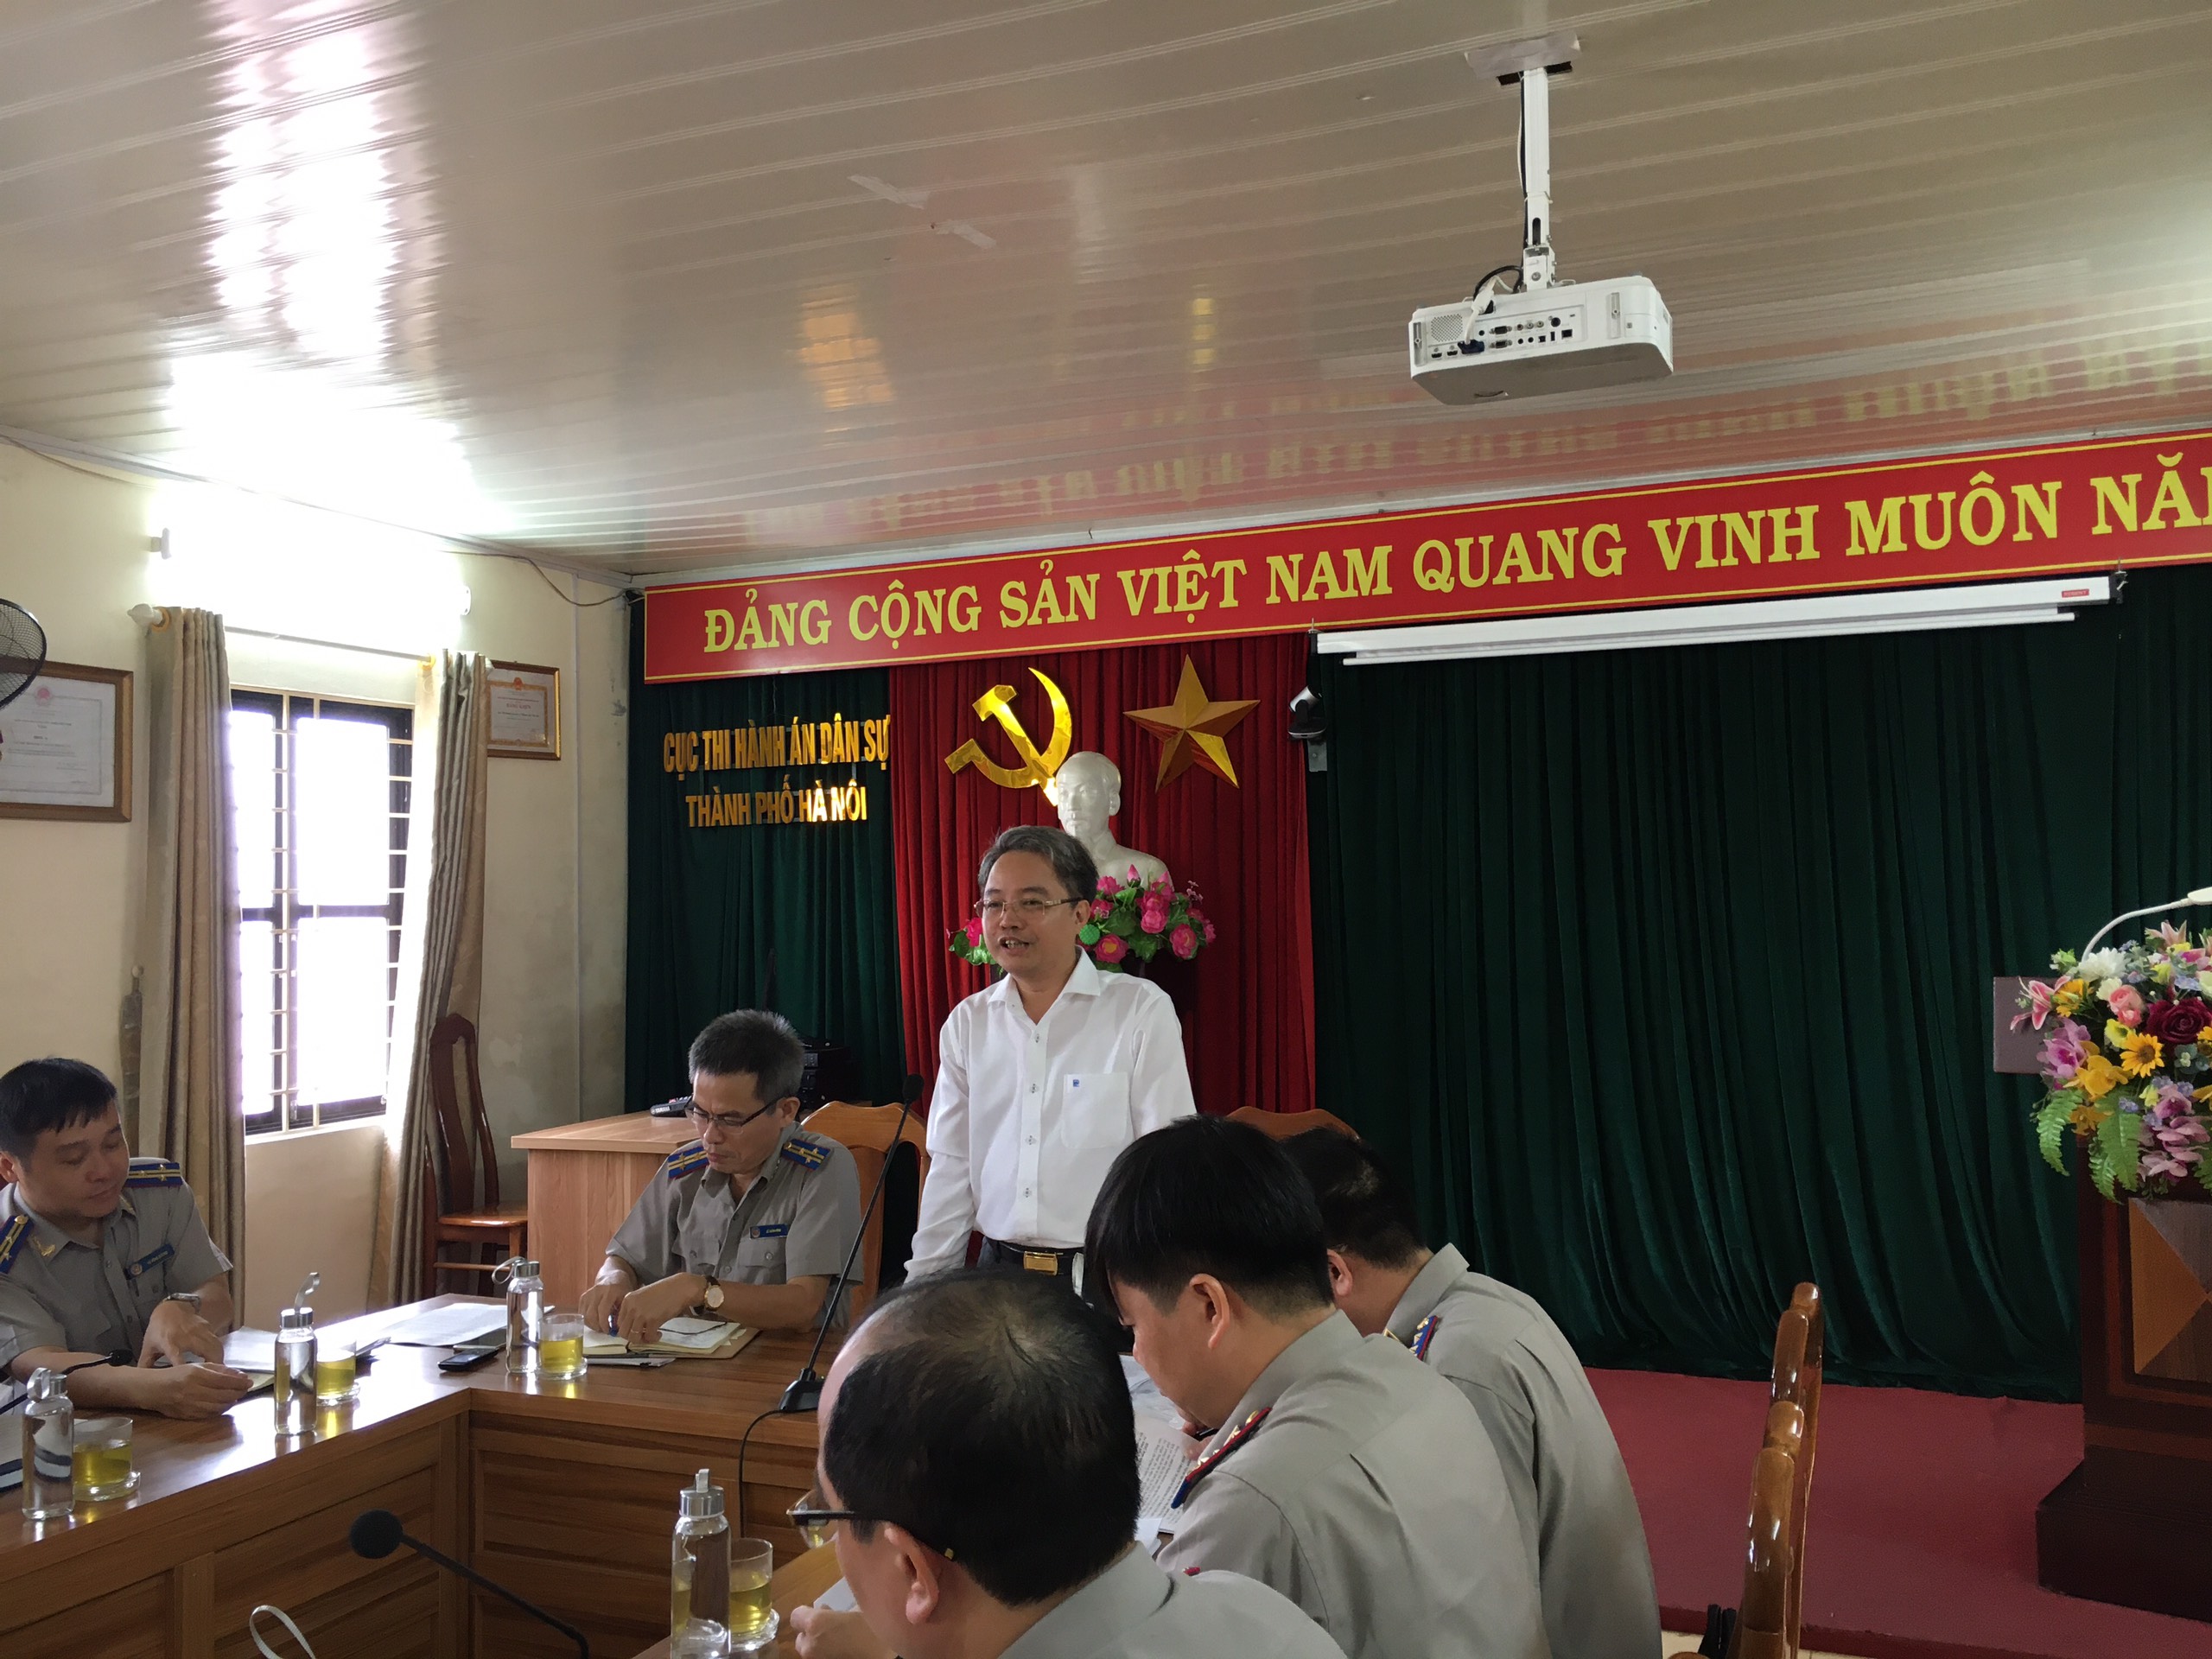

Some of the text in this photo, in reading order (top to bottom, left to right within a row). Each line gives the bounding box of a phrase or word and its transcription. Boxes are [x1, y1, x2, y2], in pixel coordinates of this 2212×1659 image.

[705, 452, 2212, 652] ĐẢNG CỘNG SẢN VIỆT NAM QUANG VINH MUÔN NĂ
[664, 712, 891, 781] CỤC THI HÀNH ÁN DÂN SỰ
[685, 785, 752, 827] THÀNH
[755, 774, 794, 824] PHỐ
[798, 779, 828, 823] HÀ
